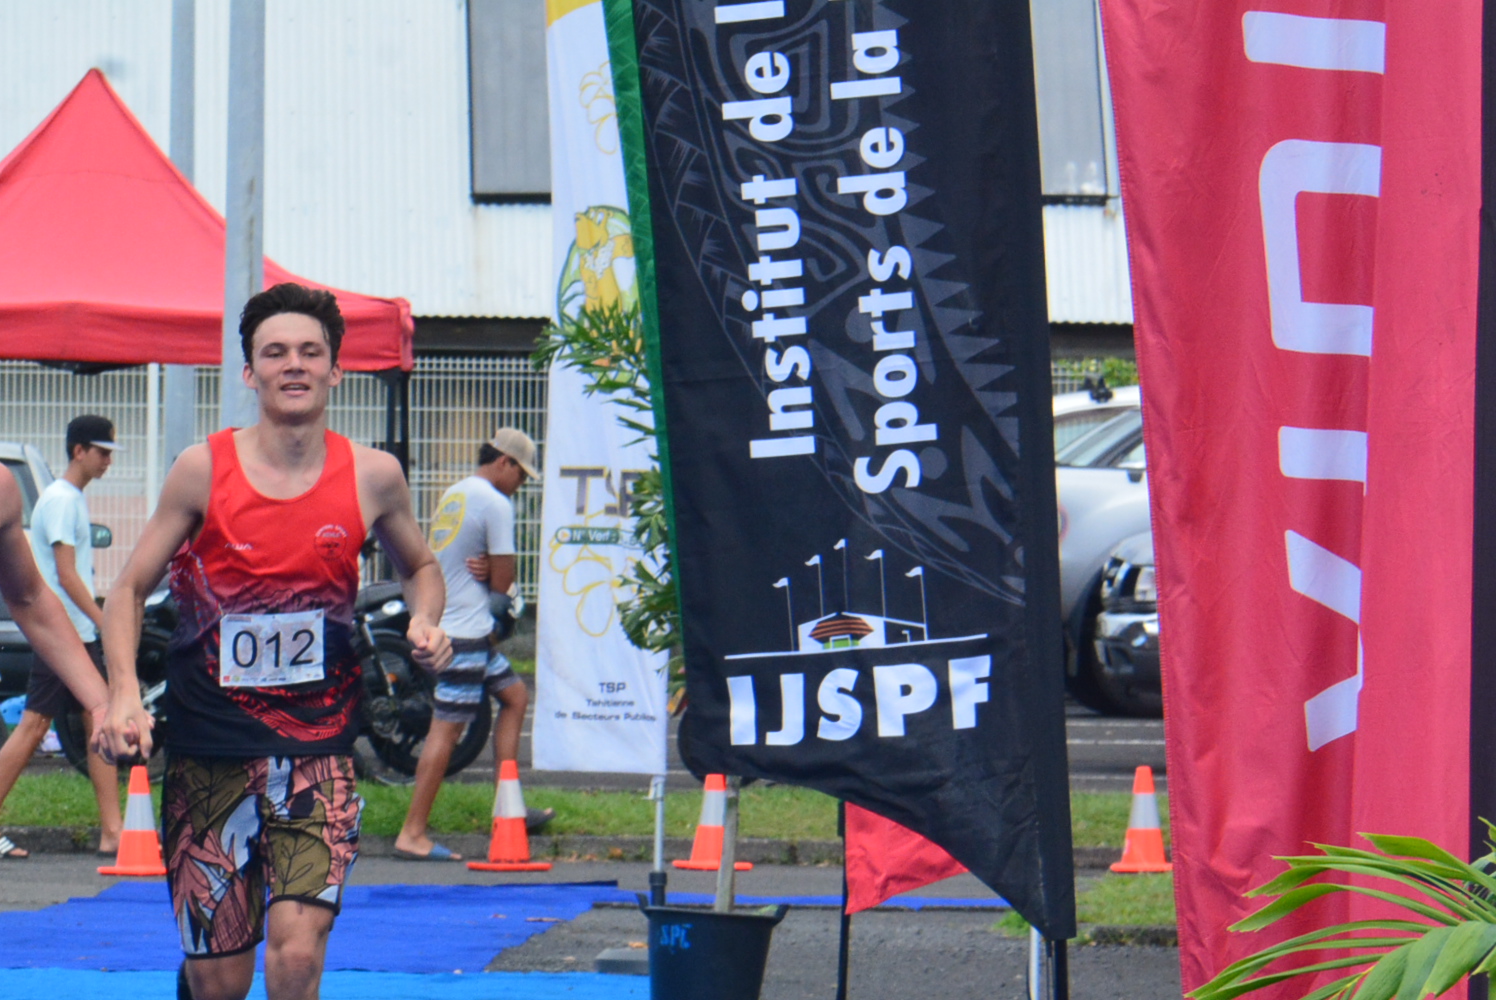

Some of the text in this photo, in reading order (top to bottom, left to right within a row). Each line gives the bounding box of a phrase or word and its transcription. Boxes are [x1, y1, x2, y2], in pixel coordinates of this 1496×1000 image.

[721, 51, 794, 143] de
[830, 29, 938, 494] Sports de la
[741, 174, 816, 459] Institut
[232, 629, 315, 668] 012
[598, 681, 627, 693] TSP
[727, 654, 991, 746] IJSPF
